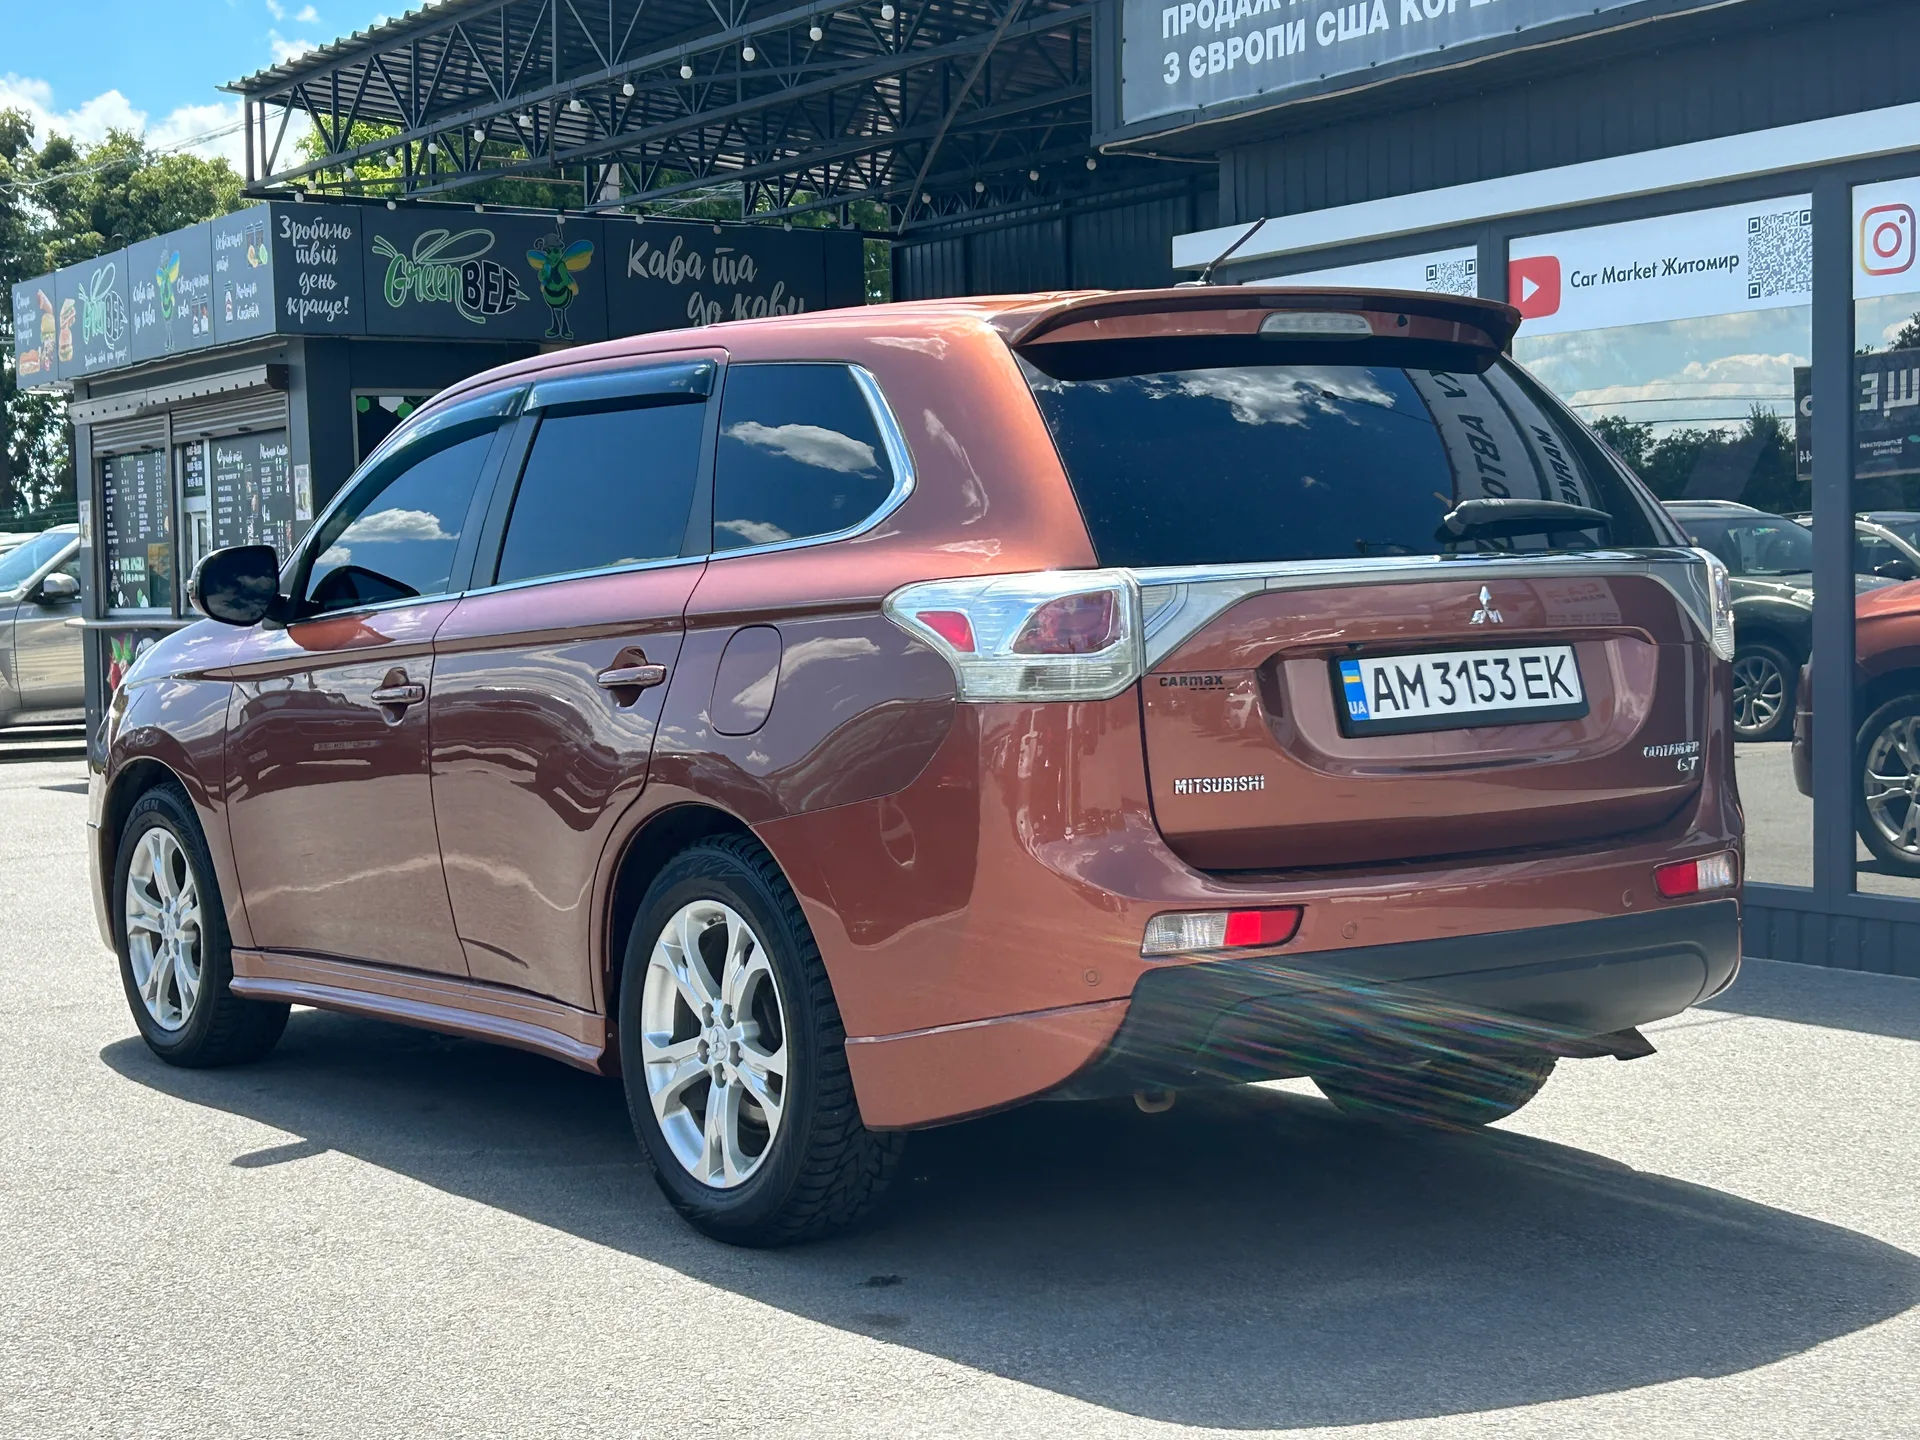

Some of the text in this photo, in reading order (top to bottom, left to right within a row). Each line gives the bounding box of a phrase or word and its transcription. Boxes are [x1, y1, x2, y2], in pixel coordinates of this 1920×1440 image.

[1163, 52, 1181, 85] З
[1188, 18, 1306, 79] ЄВРОПИ
[1315, 0, 1390, 47] США
[279, 214, 353, 248] Зробимо
[295, 240, 338, 266] твій
[627, 235, 758, 285] Кава та
[298, 272, 338, 296] день
[1570, 254, 1740, 288] Car Market Житомир
[285, 296, 350, 325] краще!
[687, 291, 724, 327] до
[1159, 675, 1224, 687] CARmax
[1349, 701, 1368, 714] UA
[1174, 774, 1265, 795] MITSUBISHI
